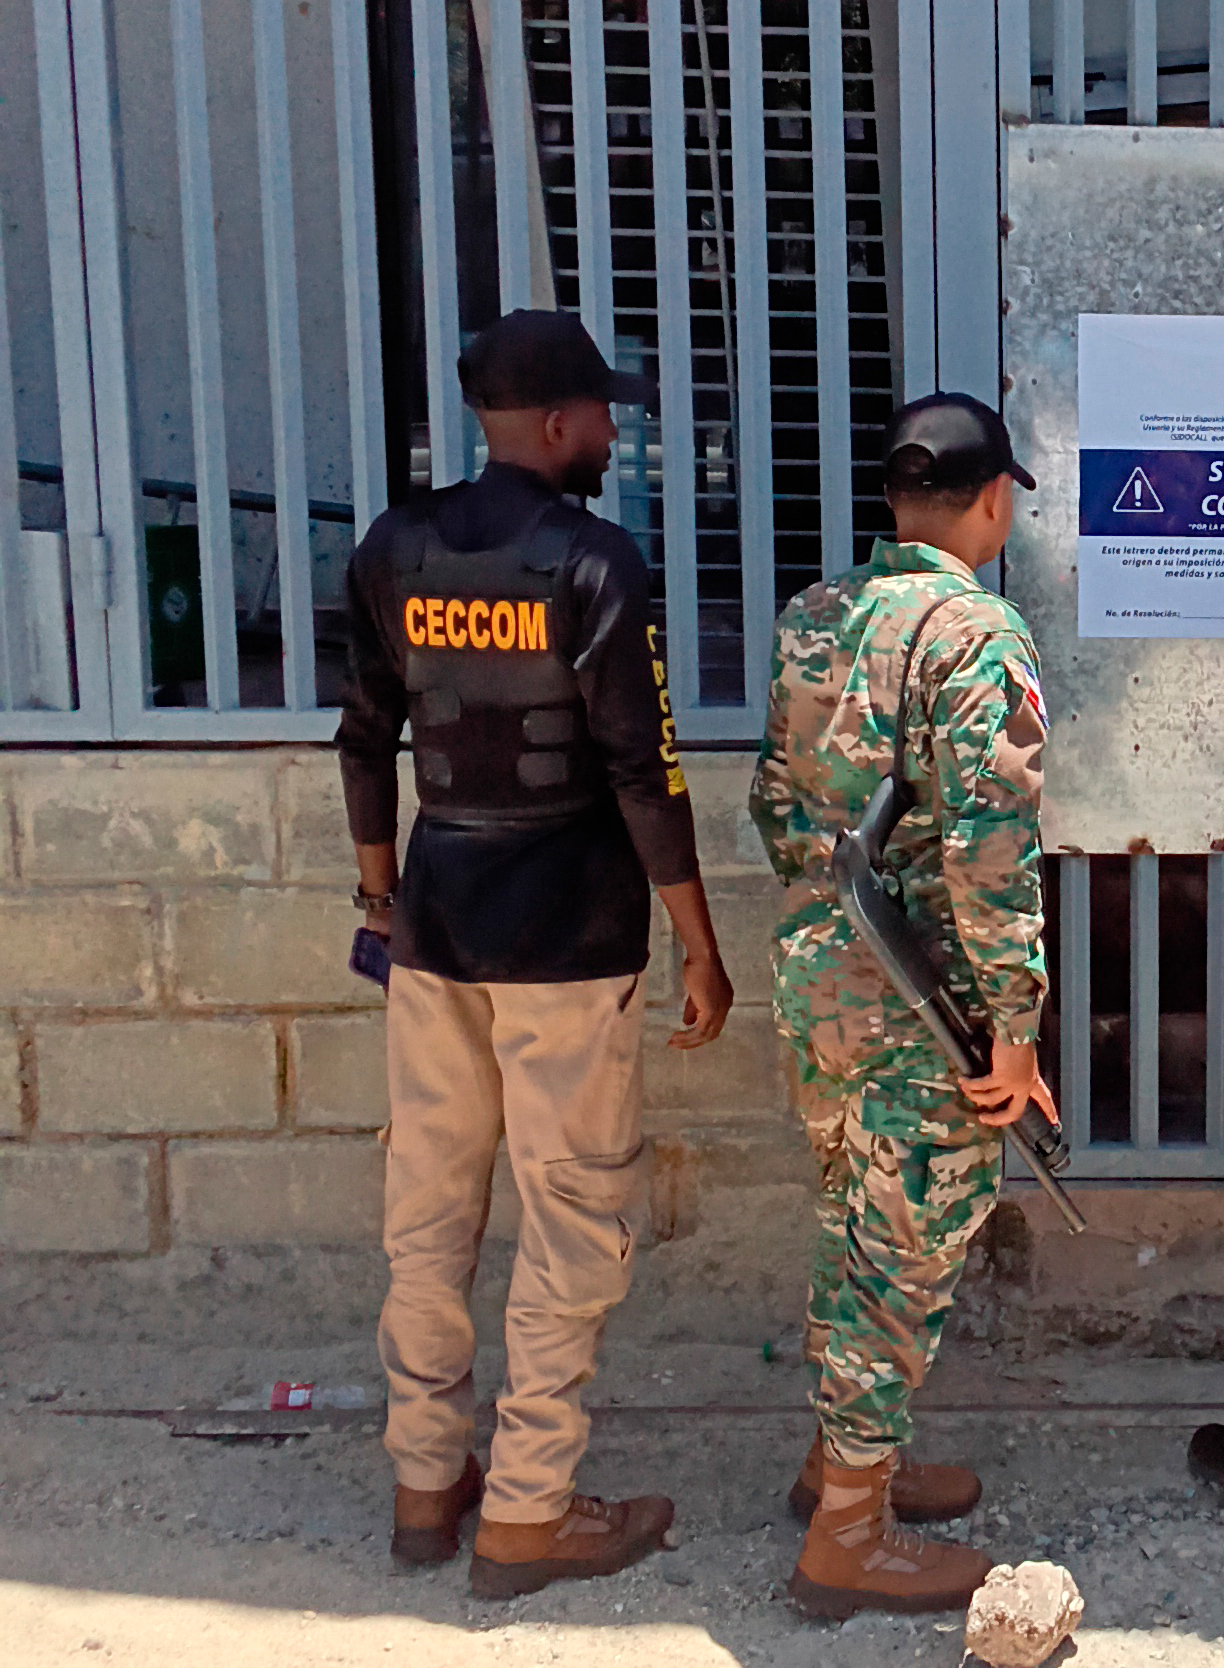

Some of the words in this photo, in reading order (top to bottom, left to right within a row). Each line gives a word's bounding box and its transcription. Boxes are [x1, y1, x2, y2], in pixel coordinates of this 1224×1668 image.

[1101, 545, 1121, 555] Este
[1123, 545, 1156, 555] letrero
[1157, 545, 1191, 556] deberá
[1121, 557, 1153, 568] origen
[1163, 559, 1175, 567] su
[1164, 569, 1206, 578] medidas
[1206, 571, 1214, 580] y
[1120, 609, 1132, 617] de
[1133, 609, 1181, 618] Resolución:
[404, 596, 549, 651] CECCOM
